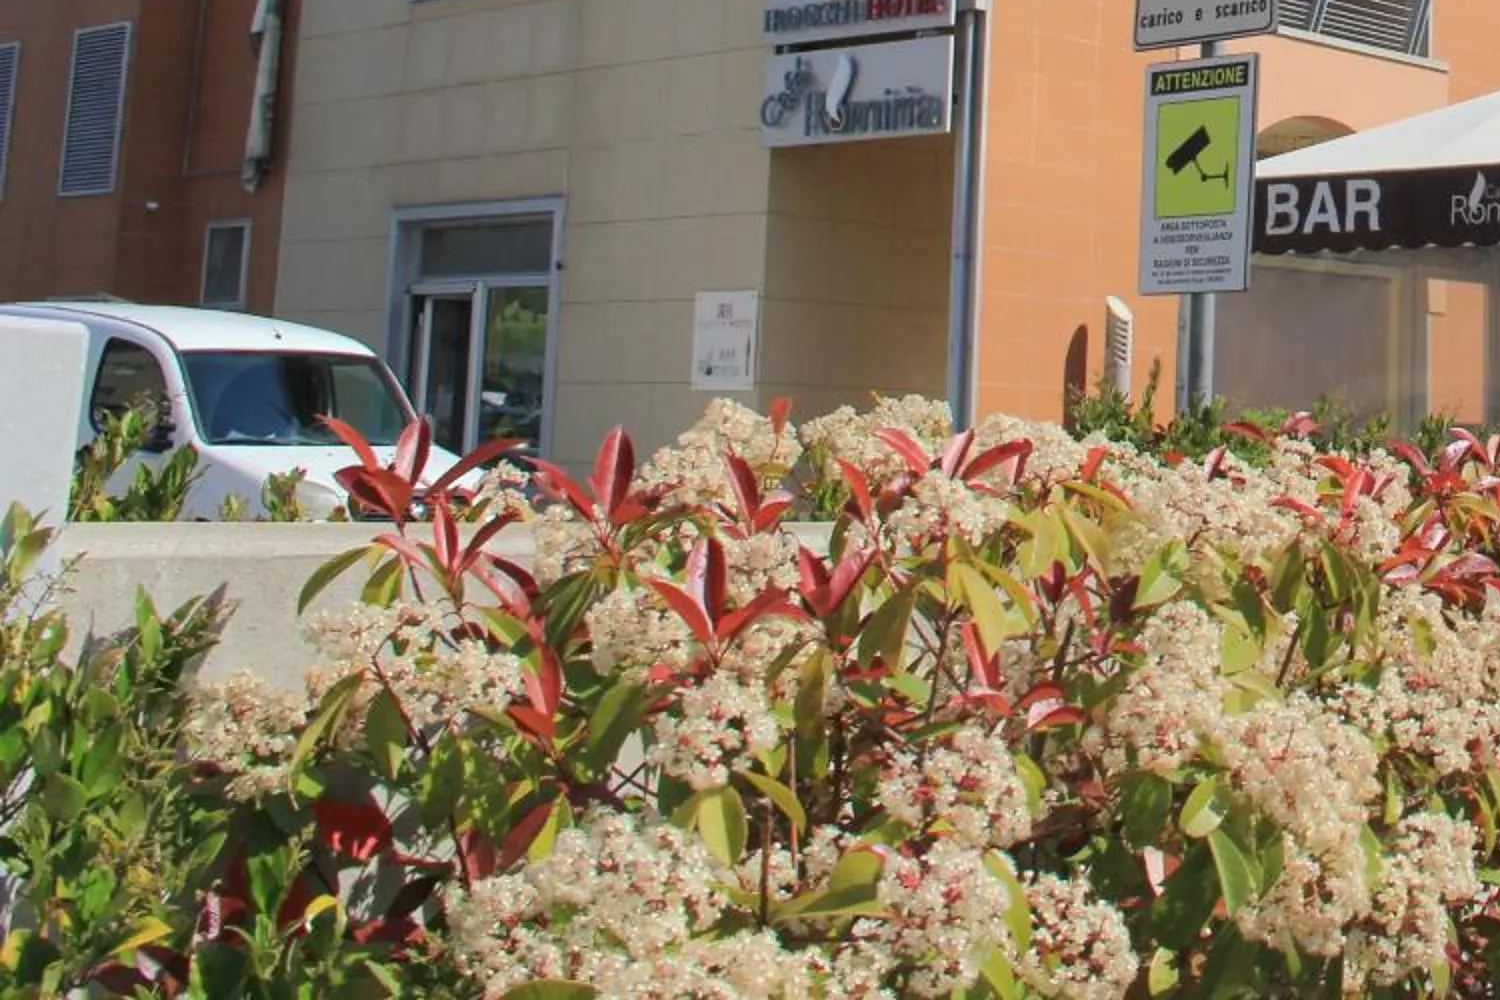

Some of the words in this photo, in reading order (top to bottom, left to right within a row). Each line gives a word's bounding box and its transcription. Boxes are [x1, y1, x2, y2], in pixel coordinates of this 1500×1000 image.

[1140, 8, 1184, 29] carico
[1195, 7, 1204, 22] e
[1155, 65, 1246, 93] ATTENZIONE
[1265, 179, 1382, 236] BAR
